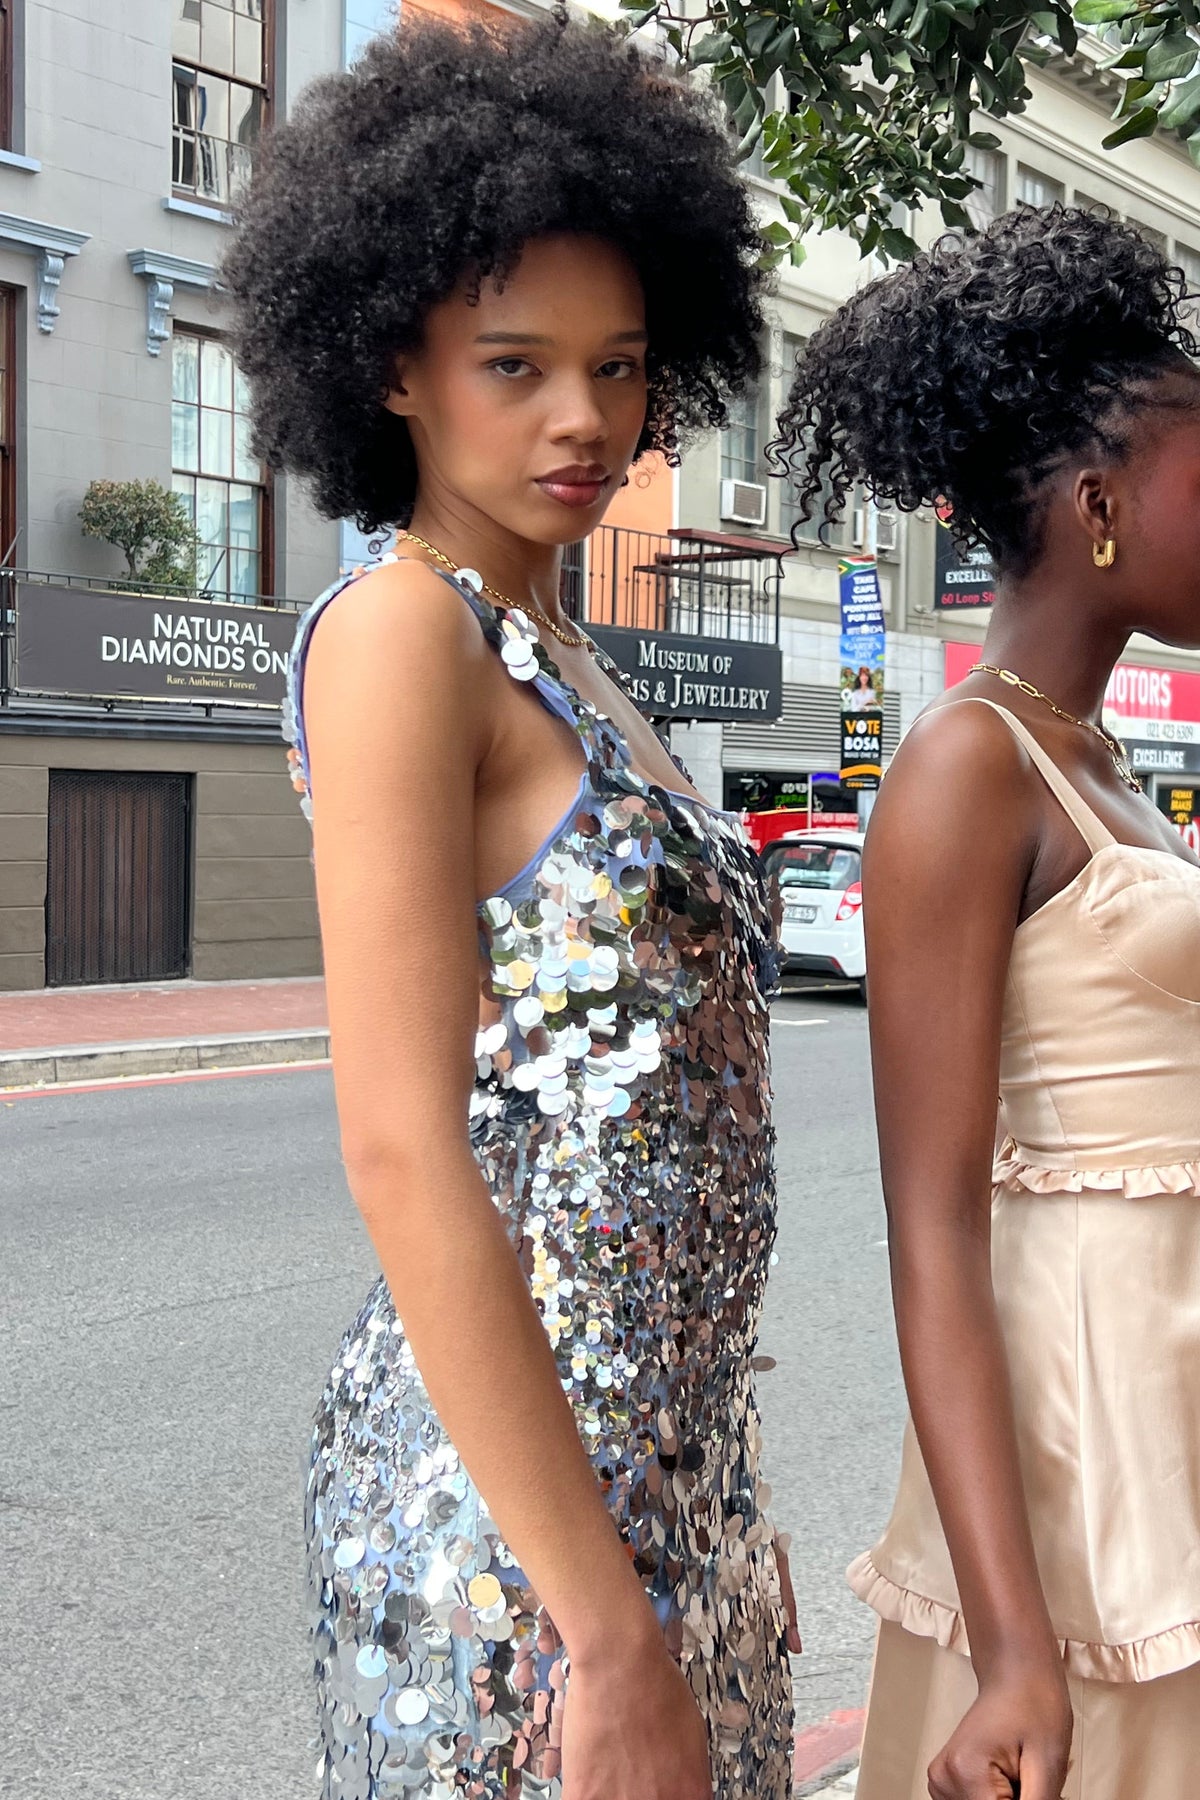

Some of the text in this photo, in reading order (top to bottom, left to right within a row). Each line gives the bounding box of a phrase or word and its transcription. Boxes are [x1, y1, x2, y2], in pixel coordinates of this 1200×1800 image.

[853, 584, 876, 594] CAPE
[941, 593, 954, 605] 60
[153, 612, 271, 648] NATURAL
[101, 635, 246, 672] DIAMONDS
[166, 674, 258, 691] Rare. Authentic. Forever.
[654, 681, 667, 703] &
[670, 674, 770, 711] JEWELLERY
[845, 720, 880, 735] VOTE
[1146, 722, 1160, 738] 021
[844, 737, 880, 751] BOSA
[1133, 748, 1185, 769] EXCELLENCE
